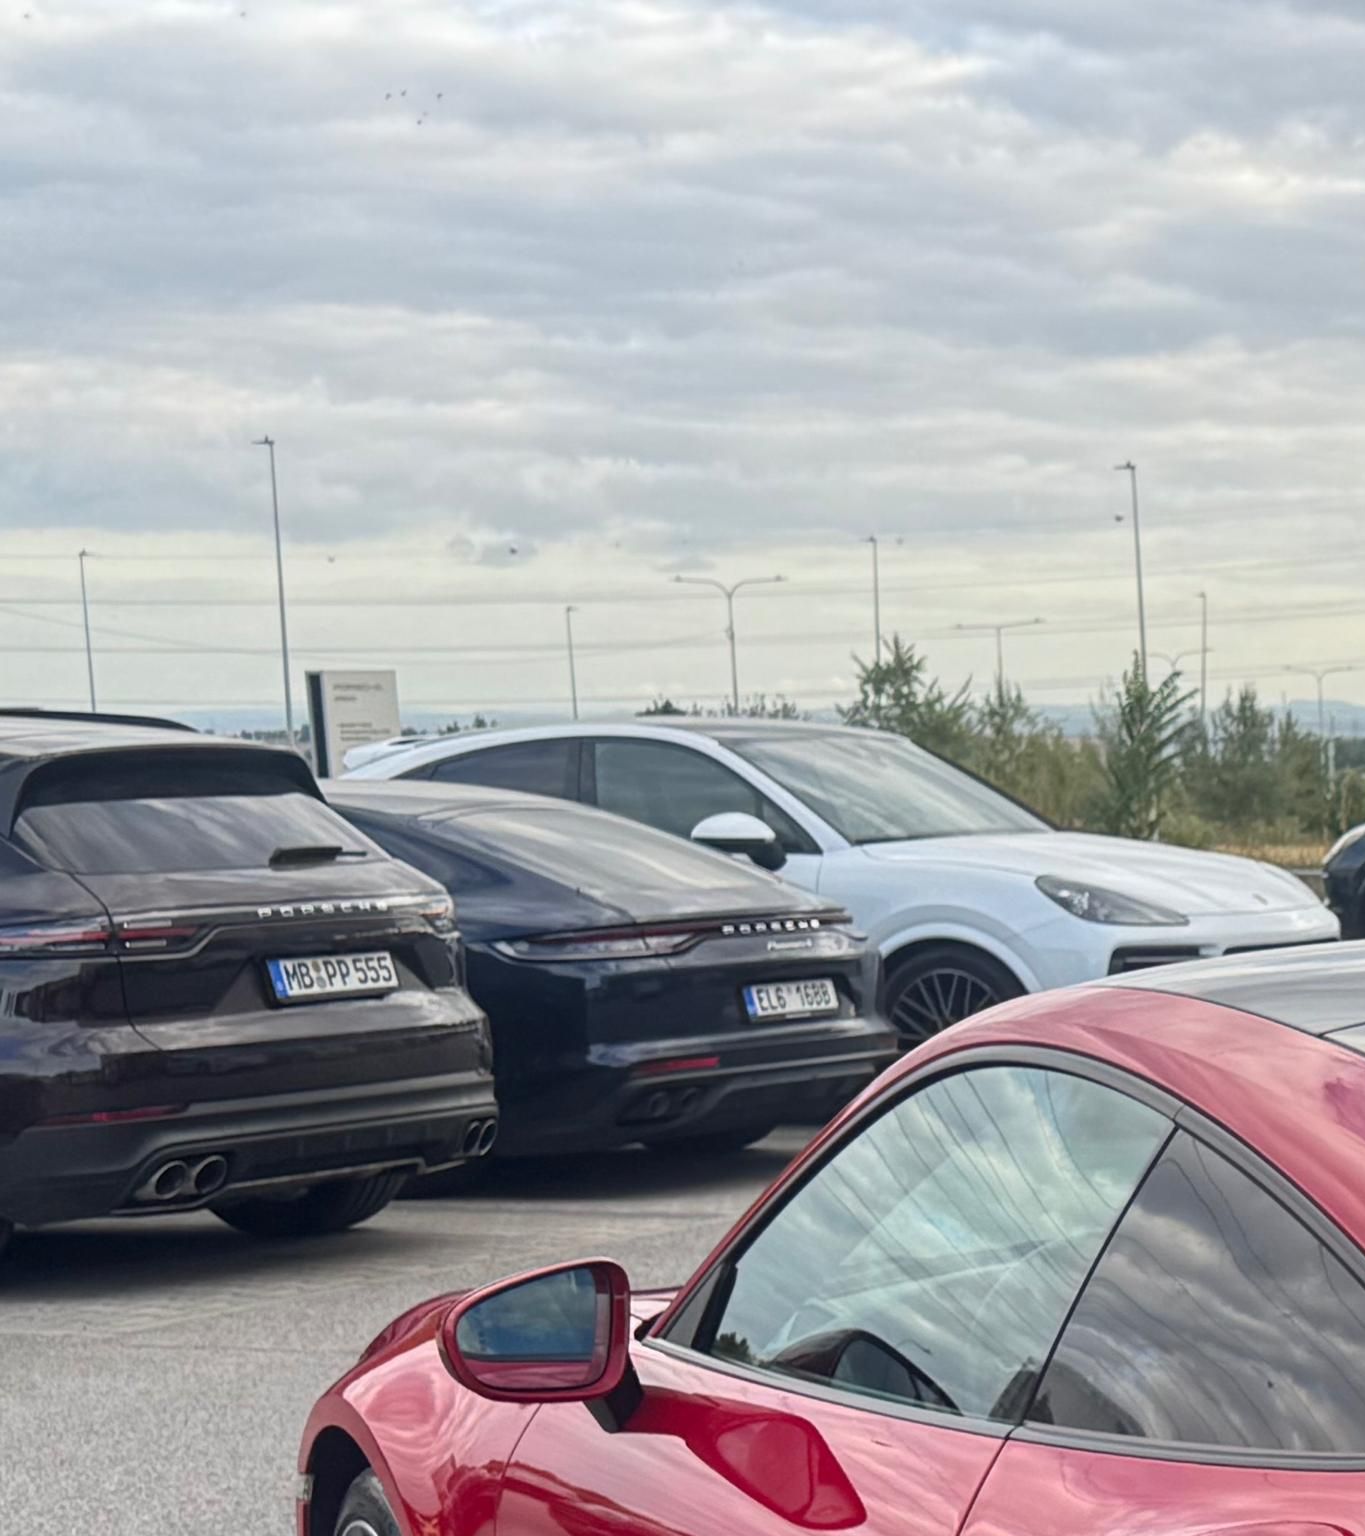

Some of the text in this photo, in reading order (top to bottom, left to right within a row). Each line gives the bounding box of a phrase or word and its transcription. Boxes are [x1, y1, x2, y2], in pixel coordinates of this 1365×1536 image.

[257, 900, 388, 919] PORSCHE
[721, 918, 821, 935] PORSCHE
[283, 955, 393, 991] MB PP 555
